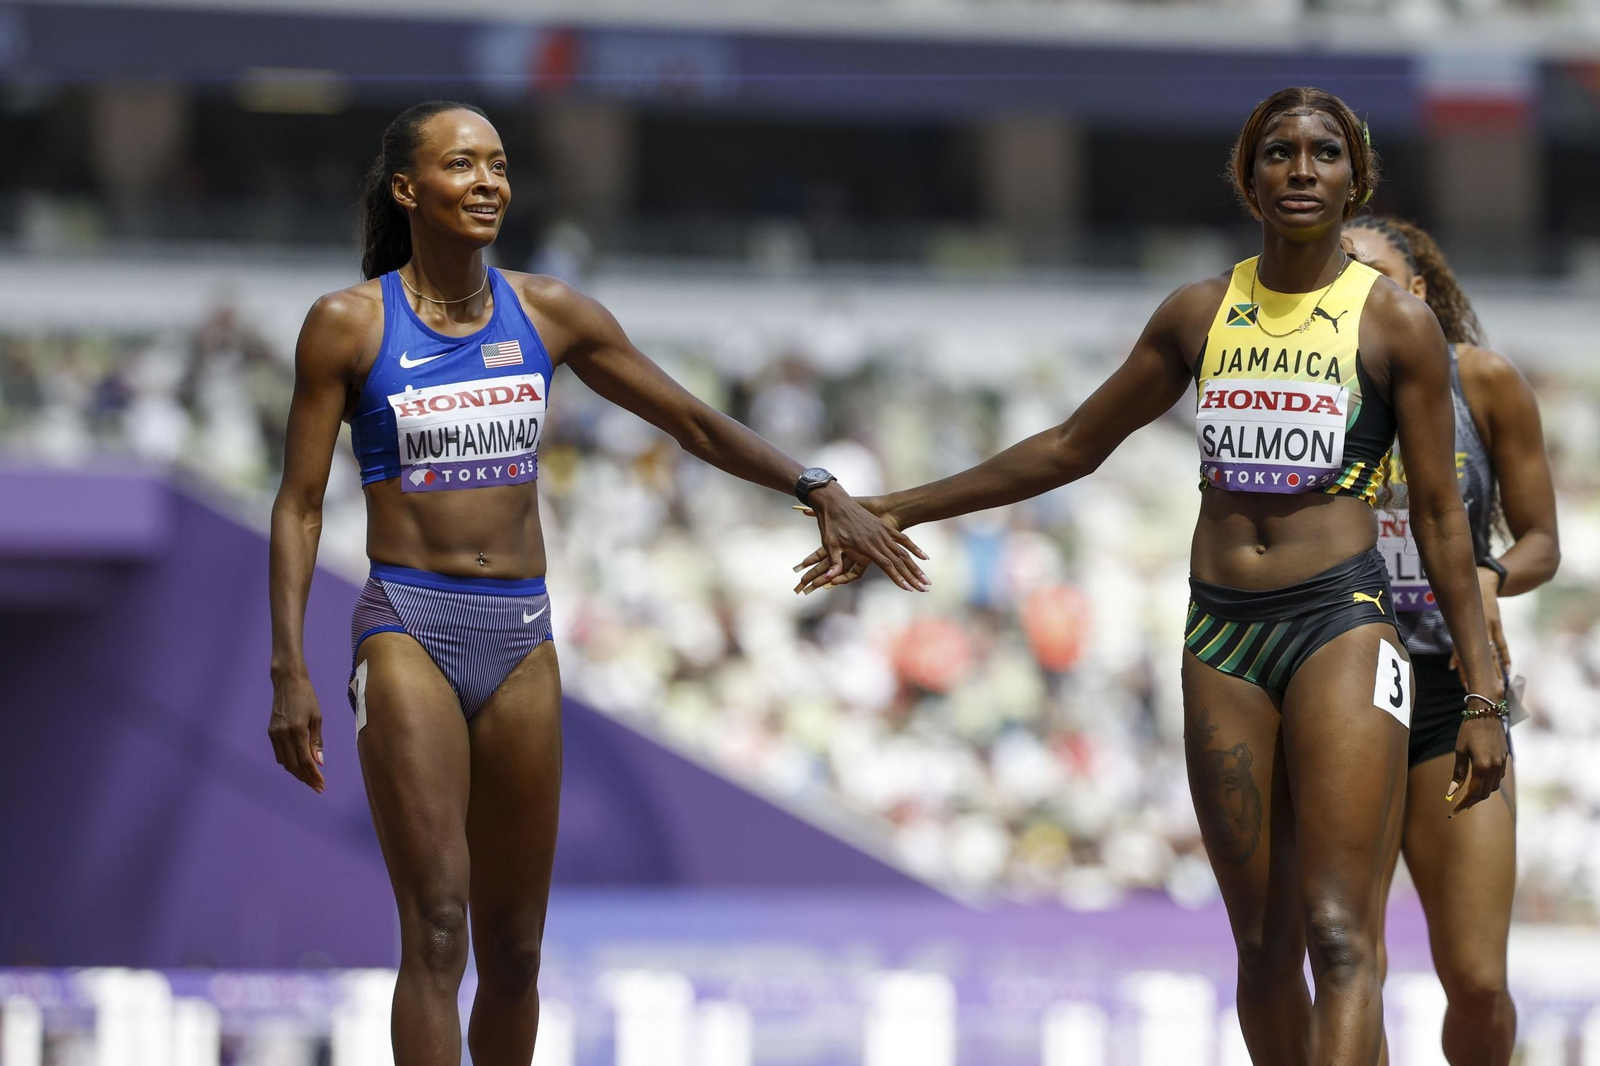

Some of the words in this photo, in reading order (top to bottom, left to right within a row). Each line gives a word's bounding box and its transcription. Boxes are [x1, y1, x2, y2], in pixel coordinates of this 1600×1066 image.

[1213, 347, 1341, 384] JAMAICA
[395, 383, 542, 418] HONDA
[1201, 389, 1343, 416] HONDA
[406, 417, 538, 460] MUHAMMAD
[1202, 424, 1335, 464] SALMON
[1389, 658, 1404, 709] 3
